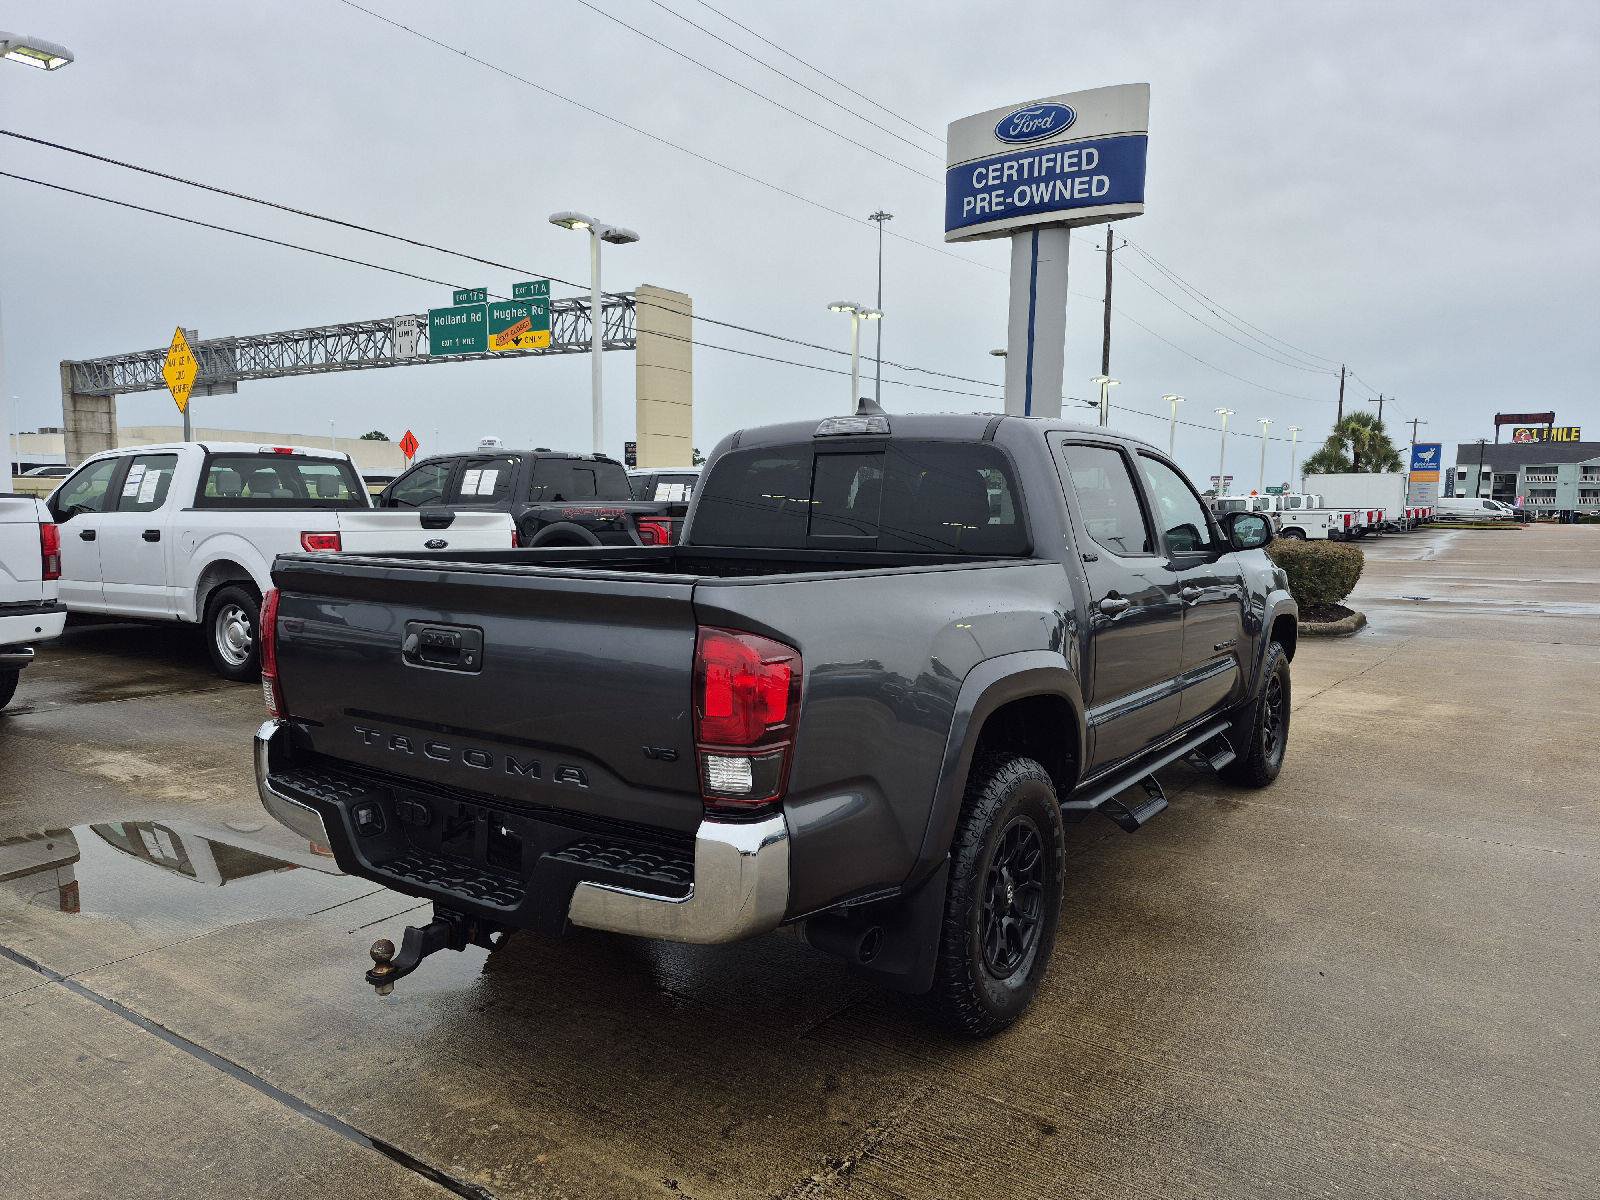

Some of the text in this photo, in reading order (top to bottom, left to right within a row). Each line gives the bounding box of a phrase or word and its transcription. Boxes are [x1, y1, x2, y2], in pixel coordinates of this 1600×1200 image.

[1009, 108, 1056, 136] Ford
[972, 147, 1099, 189] CERTIFIED
[963, 174, 1110, 218] PRE-OWNED
[515, 286, 527, 294] EXIT
[456, 293, 467, 302] EXIT
[434, 312, 482, 326] Holland Rd
[493, 304, 544, 321] Hughes Rd
[396, 319, 415, 328] SPEED
[398, 330, 413, 338] LIMIT
[441, 339, 453, 347] EXIT
[462, 337, 475, 345] MILE
[353, 725, 590, 788] TACOMA
